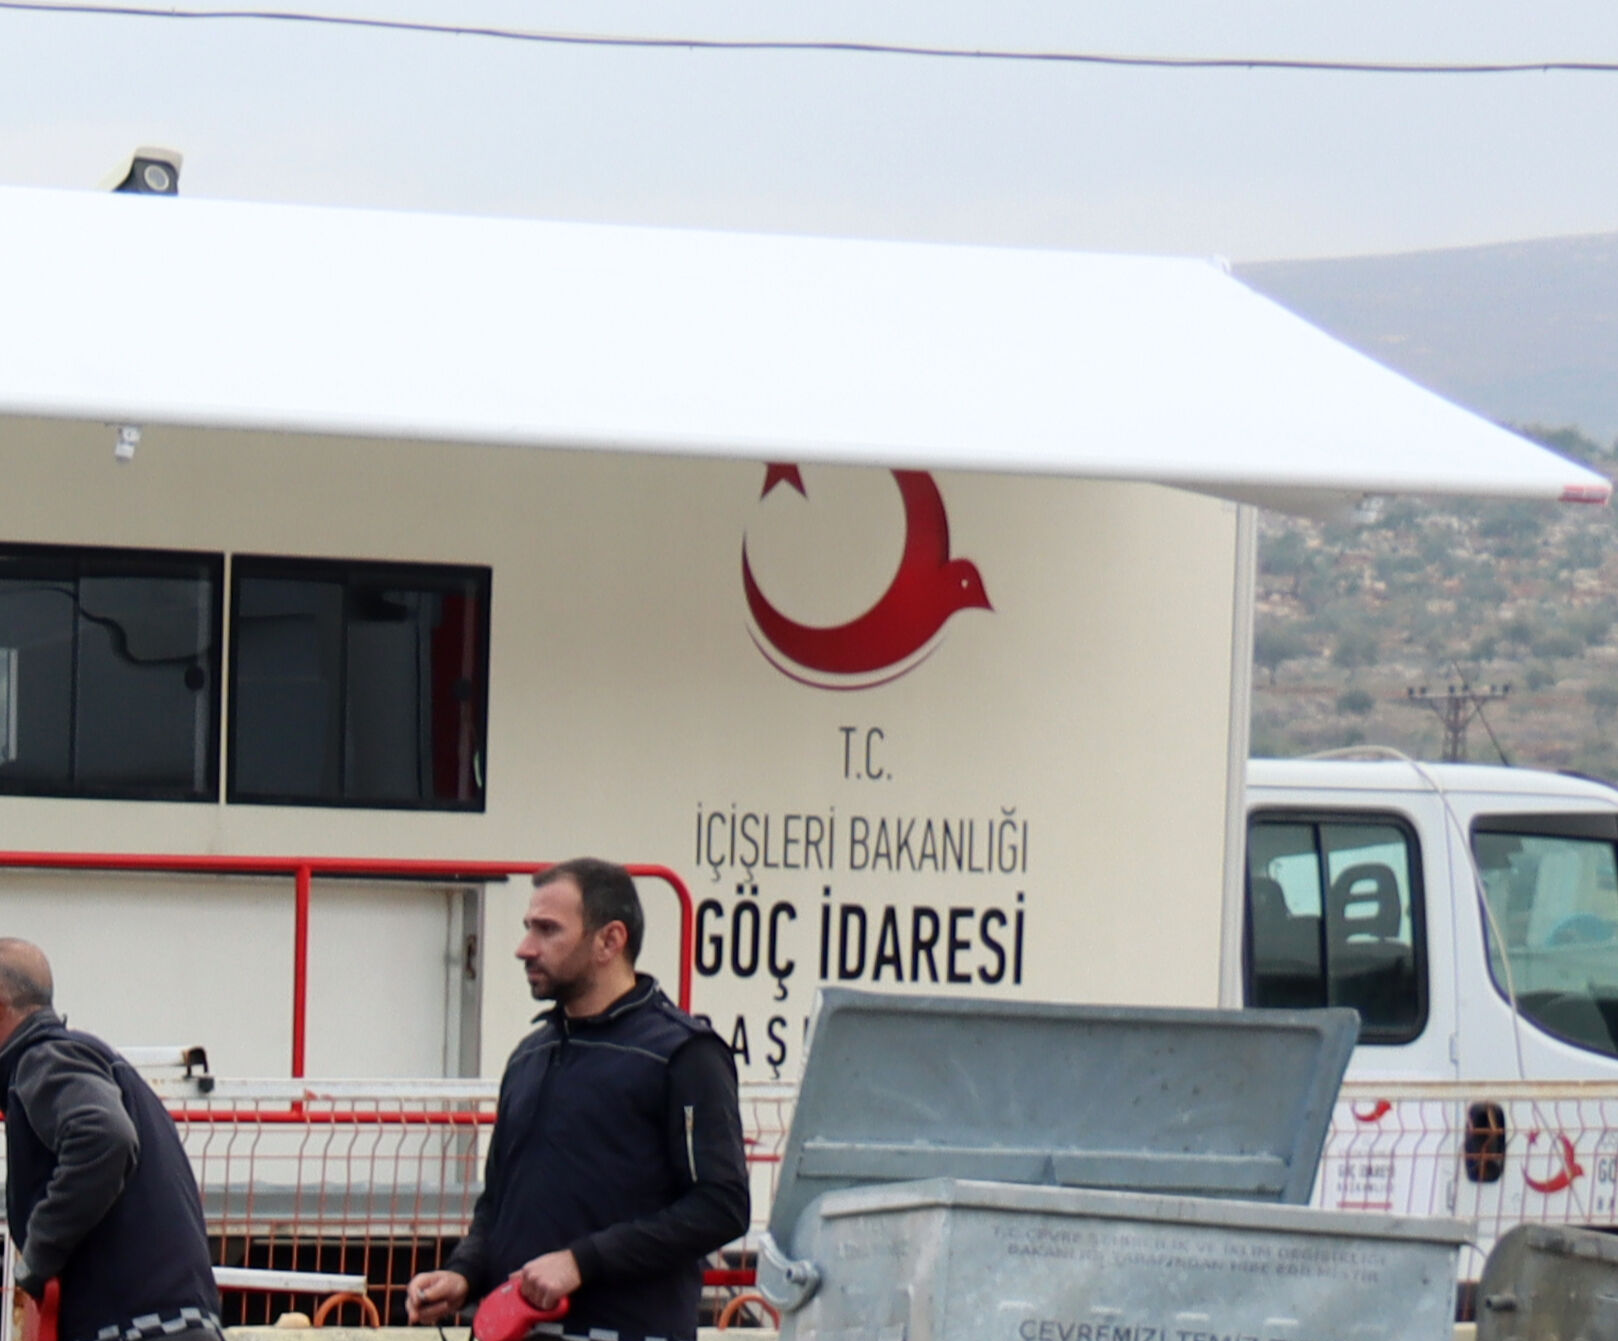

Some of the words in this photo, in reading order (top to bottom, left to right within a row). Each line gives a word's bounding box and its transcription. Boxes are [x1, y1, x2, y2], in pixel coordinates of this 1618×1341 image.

[839, 726, 893, 780] T.C.
[695, 802, 836, 883] İÇİŞLERİ
[848, 805, 1029, 874] BAKANLIĞI
[695, 883, 797, 1002] GÖÇ
[819, 885, 1025, 986] İDARESİ
